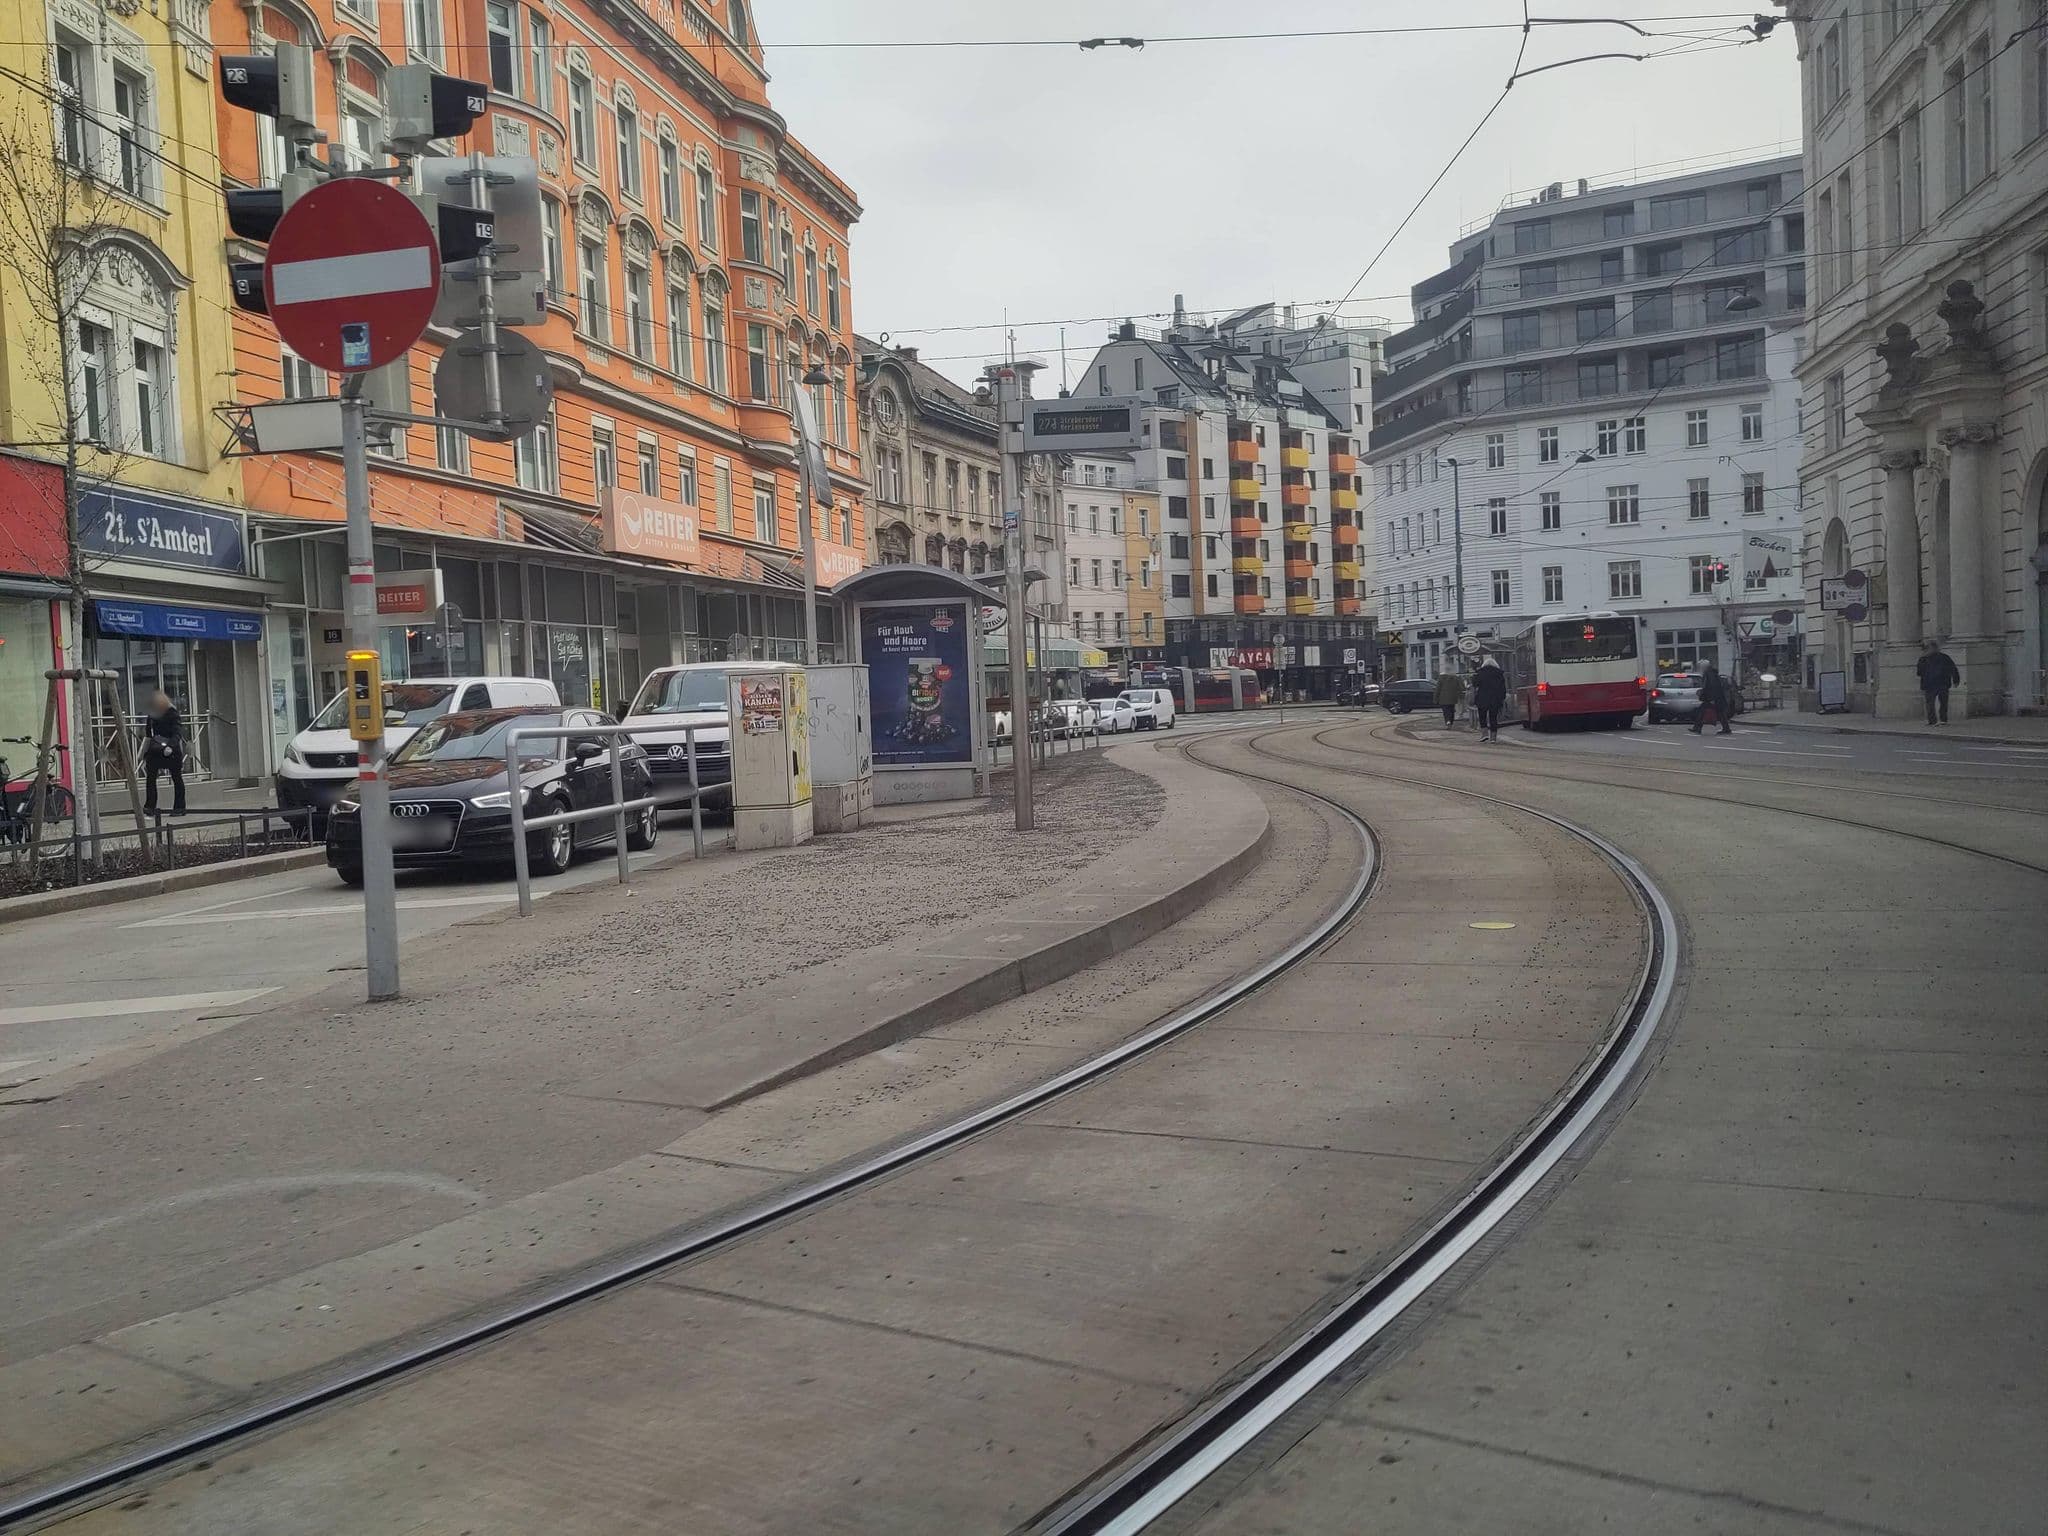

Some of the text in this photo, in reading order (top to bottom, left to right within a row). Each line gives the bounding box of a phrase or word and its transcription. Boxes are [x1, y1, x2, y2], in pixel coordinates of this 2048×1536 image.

[228, 69, 247, 83] 23
[468, 97, 484, 111] 21
[478, 223, 493, 238] 19
[643, 507, 694, 542] REITER
[831, 552, 862, 576] REITER
[378, 591, 420, 603] REITER
[878, 625, 914, 636] Für Haut
[884, 636, 927, 646] und Haare
[744, 697, 779, 706] KANADA
